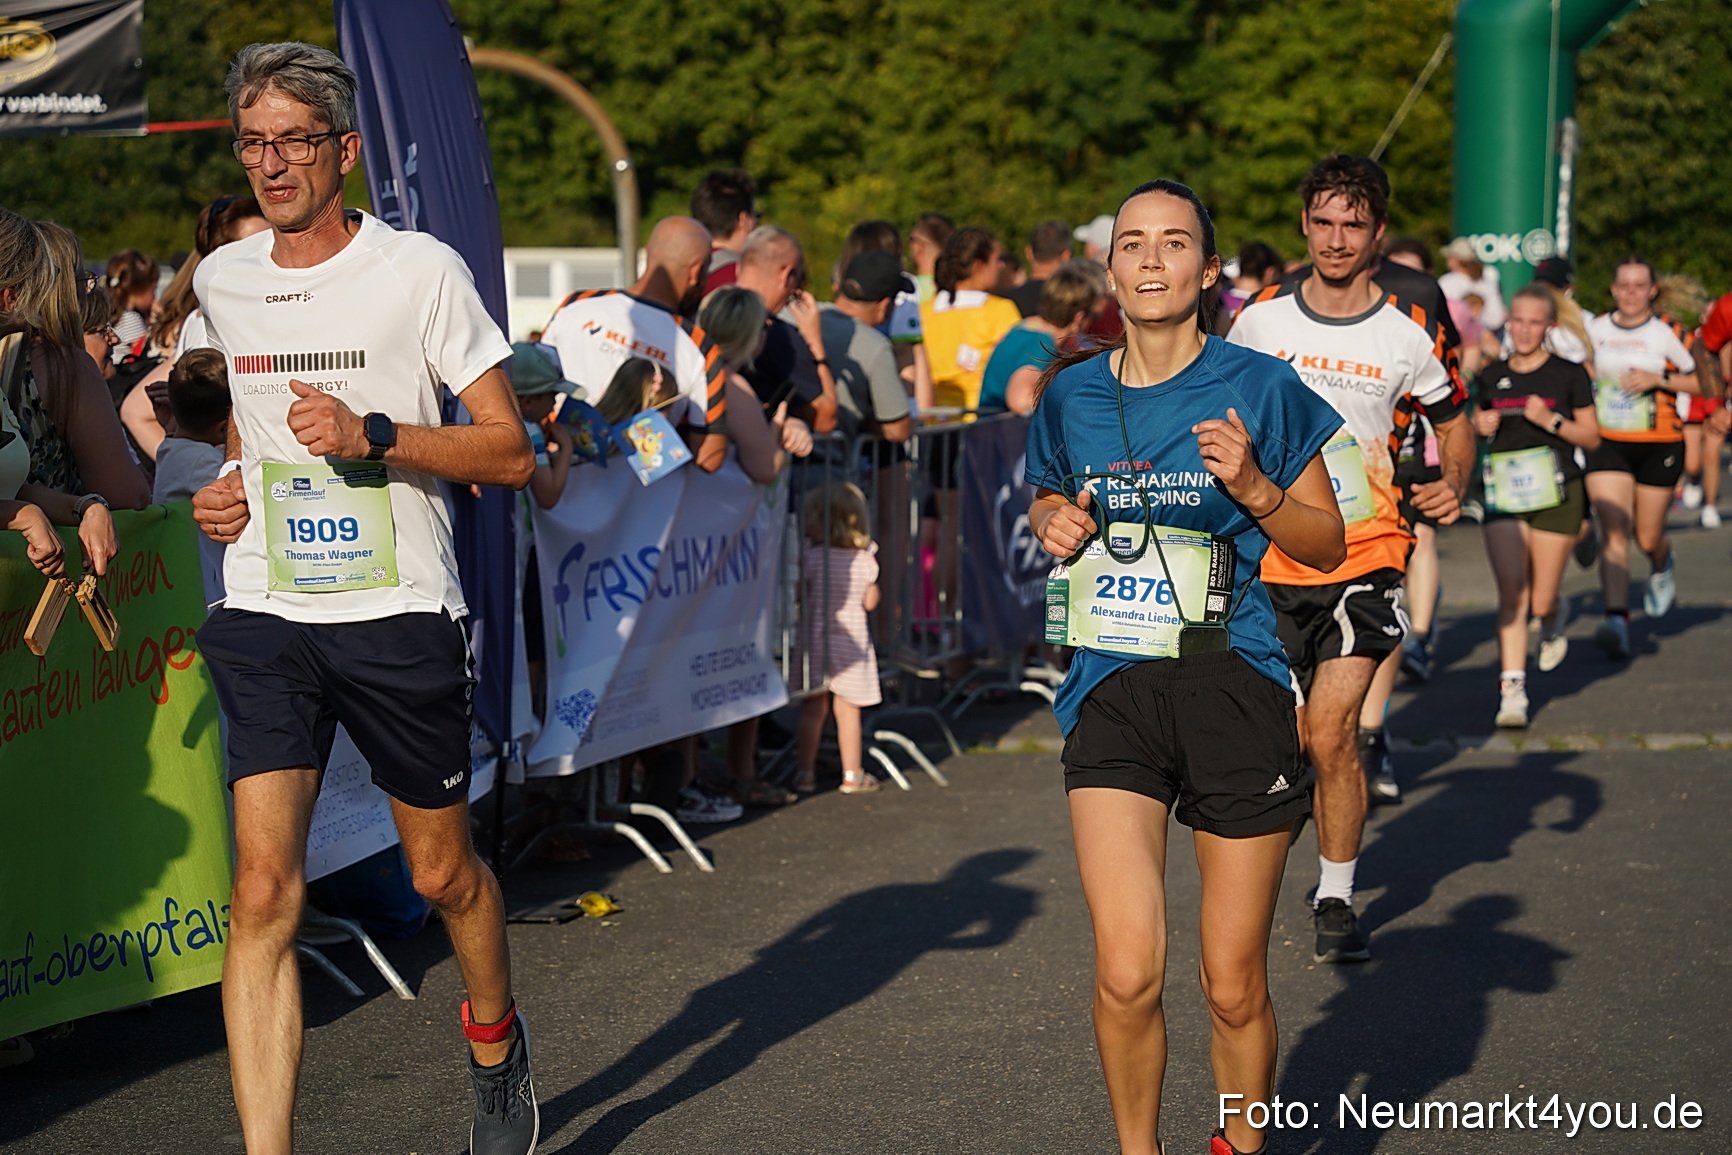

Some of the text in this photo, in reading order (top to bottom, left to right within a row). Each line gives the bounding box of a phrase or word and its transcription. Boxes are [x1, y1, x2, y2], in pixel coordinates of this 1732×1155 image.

[265, 293, 303, 304] CRAFT
[1301, 355, 1389, 382] KLEBL
[243, 384, 288, 396] LOADING
[1299, 372, 1388, 398] DYNAMICS
[1106, 471, 1217, 491] REHAKLINIK
[288, 488, 326, 498] Firmenlauf
[1107, 489, 1201, 510] BERCHING
[286, 517, 359, 544] 1909
[284, 549, 374, 561] Thomas Wagner
[584, 528, 759, 622] FRISCHMANN
[1095, 574, 1175, 606] 2876
[1090, 605, 1145, 622] Alexandra
[0, 655, 82, 746] aufen
[321, 761, 360, 791] GISTICS
